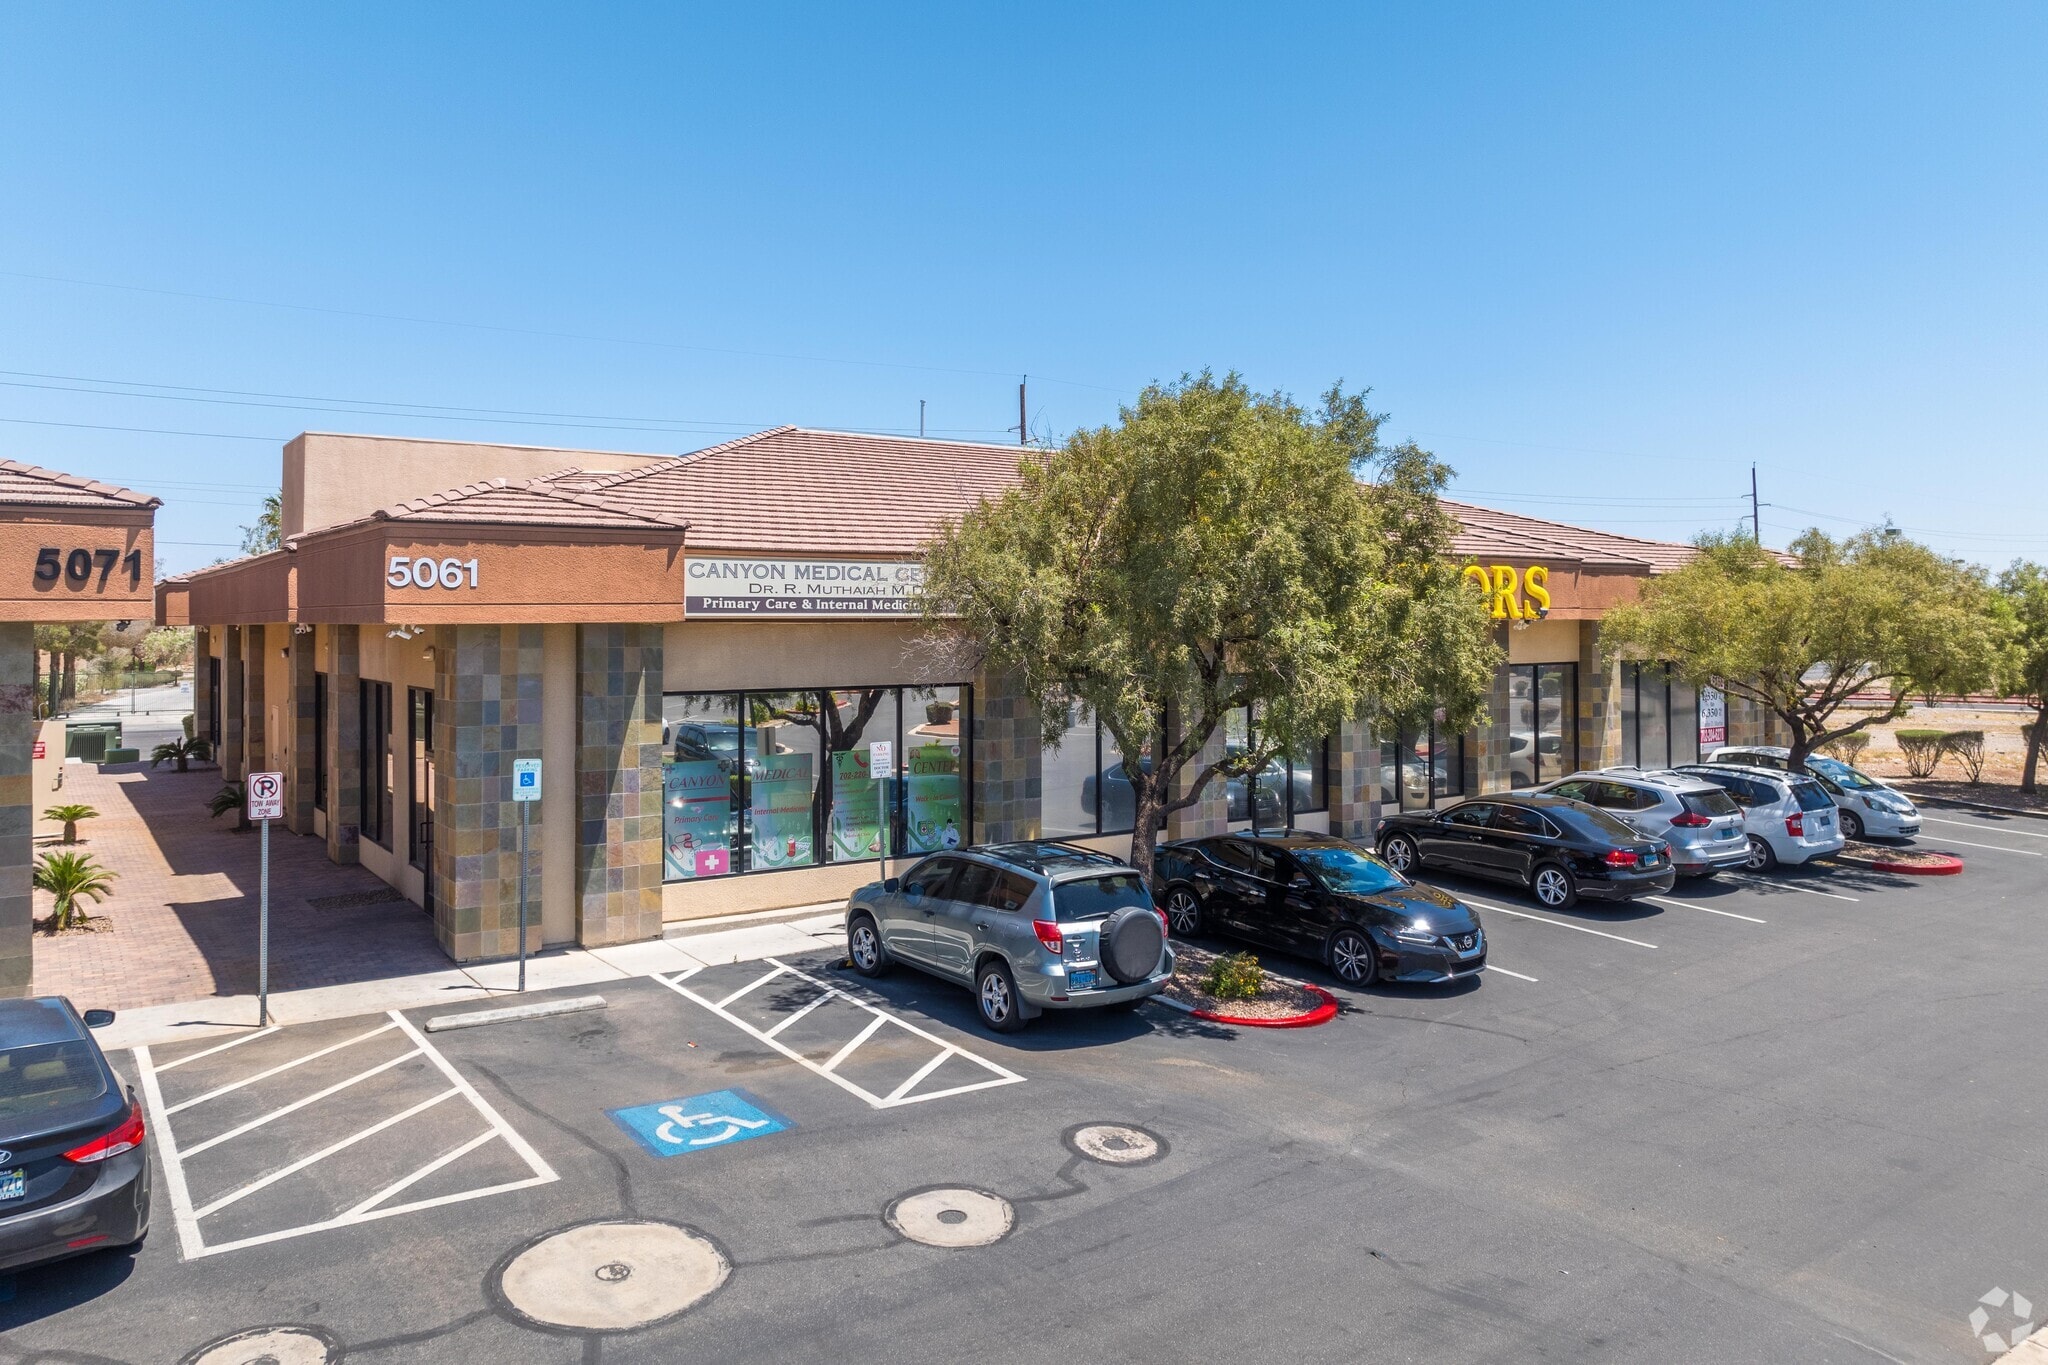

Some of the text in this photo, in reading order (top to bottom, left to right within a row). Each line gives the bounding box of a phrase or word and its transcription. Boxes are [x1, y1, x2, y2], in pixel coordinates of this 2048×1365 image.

[36, 548, 141, 581] 5071
[387, 556, 478, 588] 5061
[688, 562, 786, 580] CANYON
[794, 564, 888, 582] MEDICAL
[784, 583, 801, 595] R.
[702, 597, 760, 611] Primary
[765, 599, 797, 610] Care
[801, 599, 812, 610] &
[815, 599, 868, 610] Internal
[752, 767, 809, 781] MEDICAL
[669, 774, 725, 790] CANYON
[266, 799, 280, 807] AWAY
[674, 813, 719, 824] Primary Care
